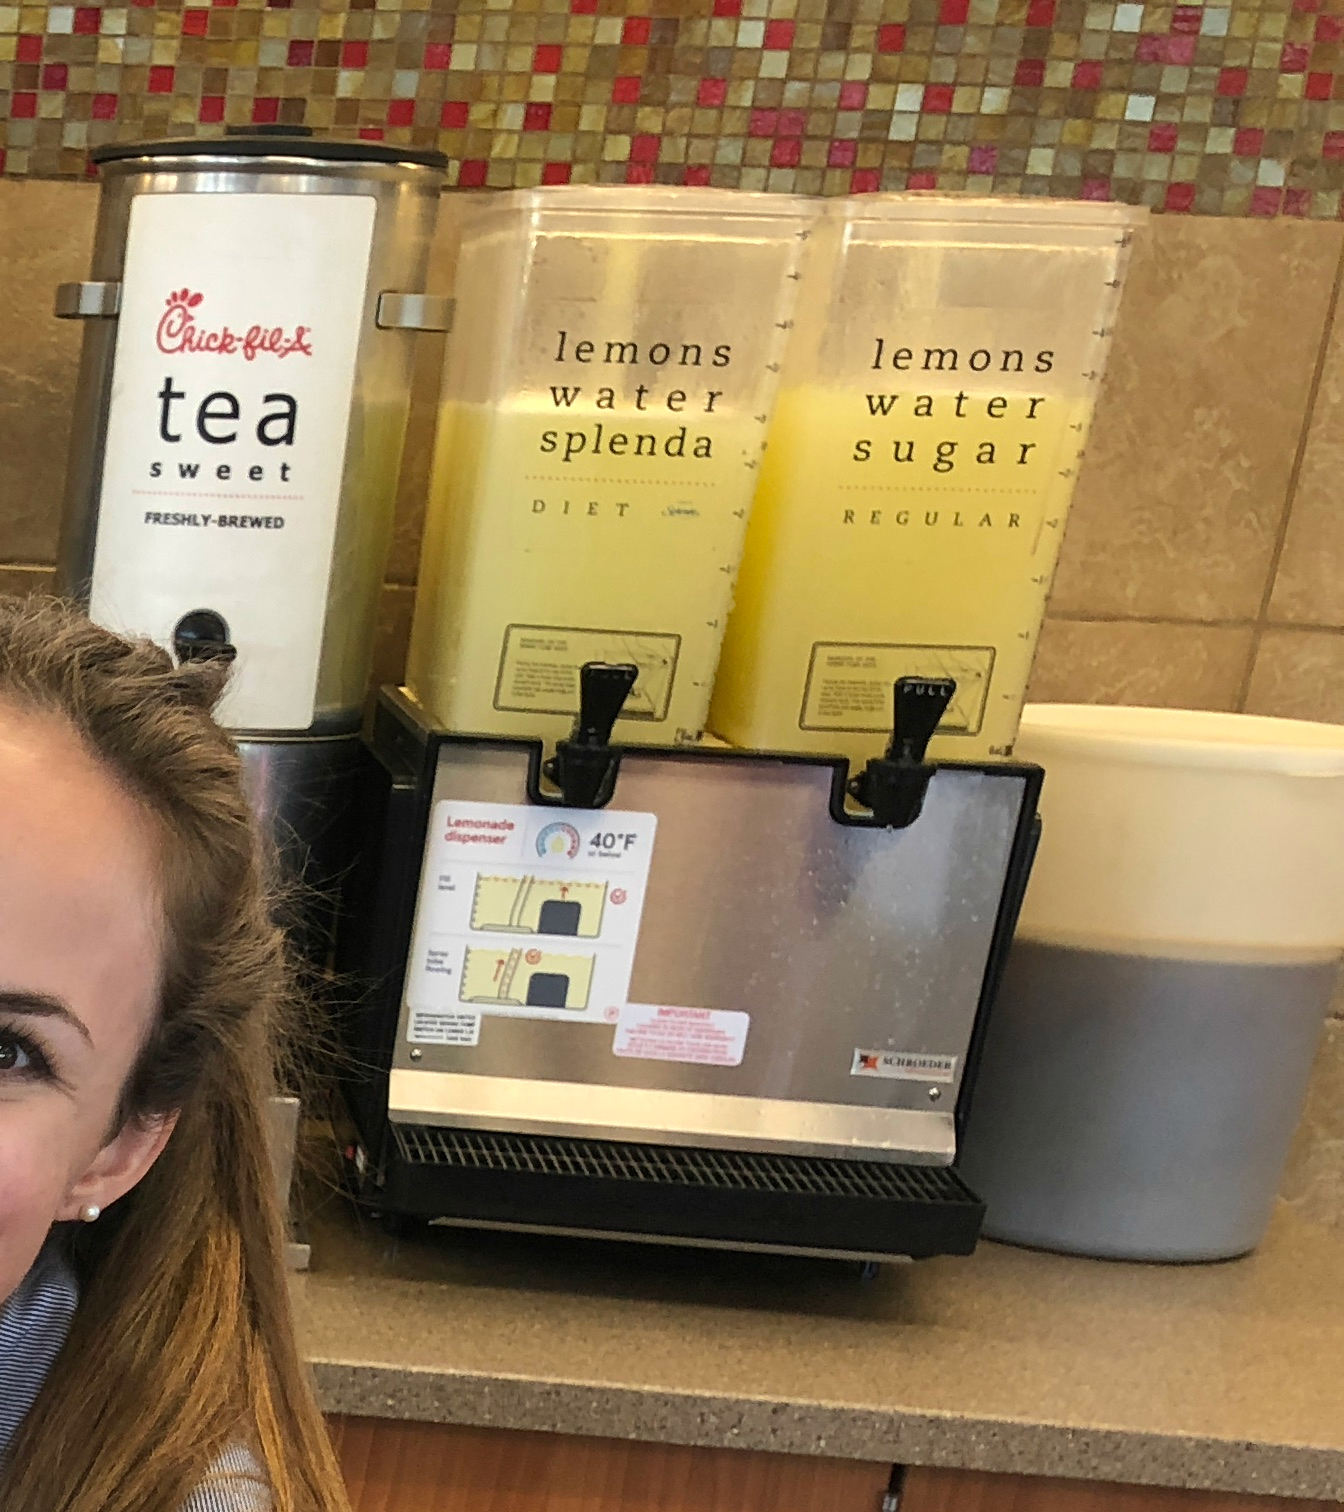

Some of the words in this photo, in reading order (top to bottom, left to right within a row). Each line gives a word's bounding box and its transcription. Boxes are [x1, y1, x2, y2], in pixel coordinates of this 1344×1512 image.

[554, 330, 732, 367] lemons
[870, 338, 1054, 373] lemons
[549, 384, 723, 413] water
[865, 390, 1046, 419] water
[157, 376, 298, 446] tea
[540, 423, 713, 462] splenda
[853, 439, 1037, 473] sugar
[149, 461, 292, 482] sweet
[531, 499, 630, 517] DIET
[843, 509, 1021, 528] REGULAR
[144, 511, 286, 529] FRESHLY-BREWED
[903, 685, 948, 697] PULL
[446, 816, 515, 831] Lemonade
[444, 831, 508, 845] dispenser
[589, 832, 638, 851] 40°F
